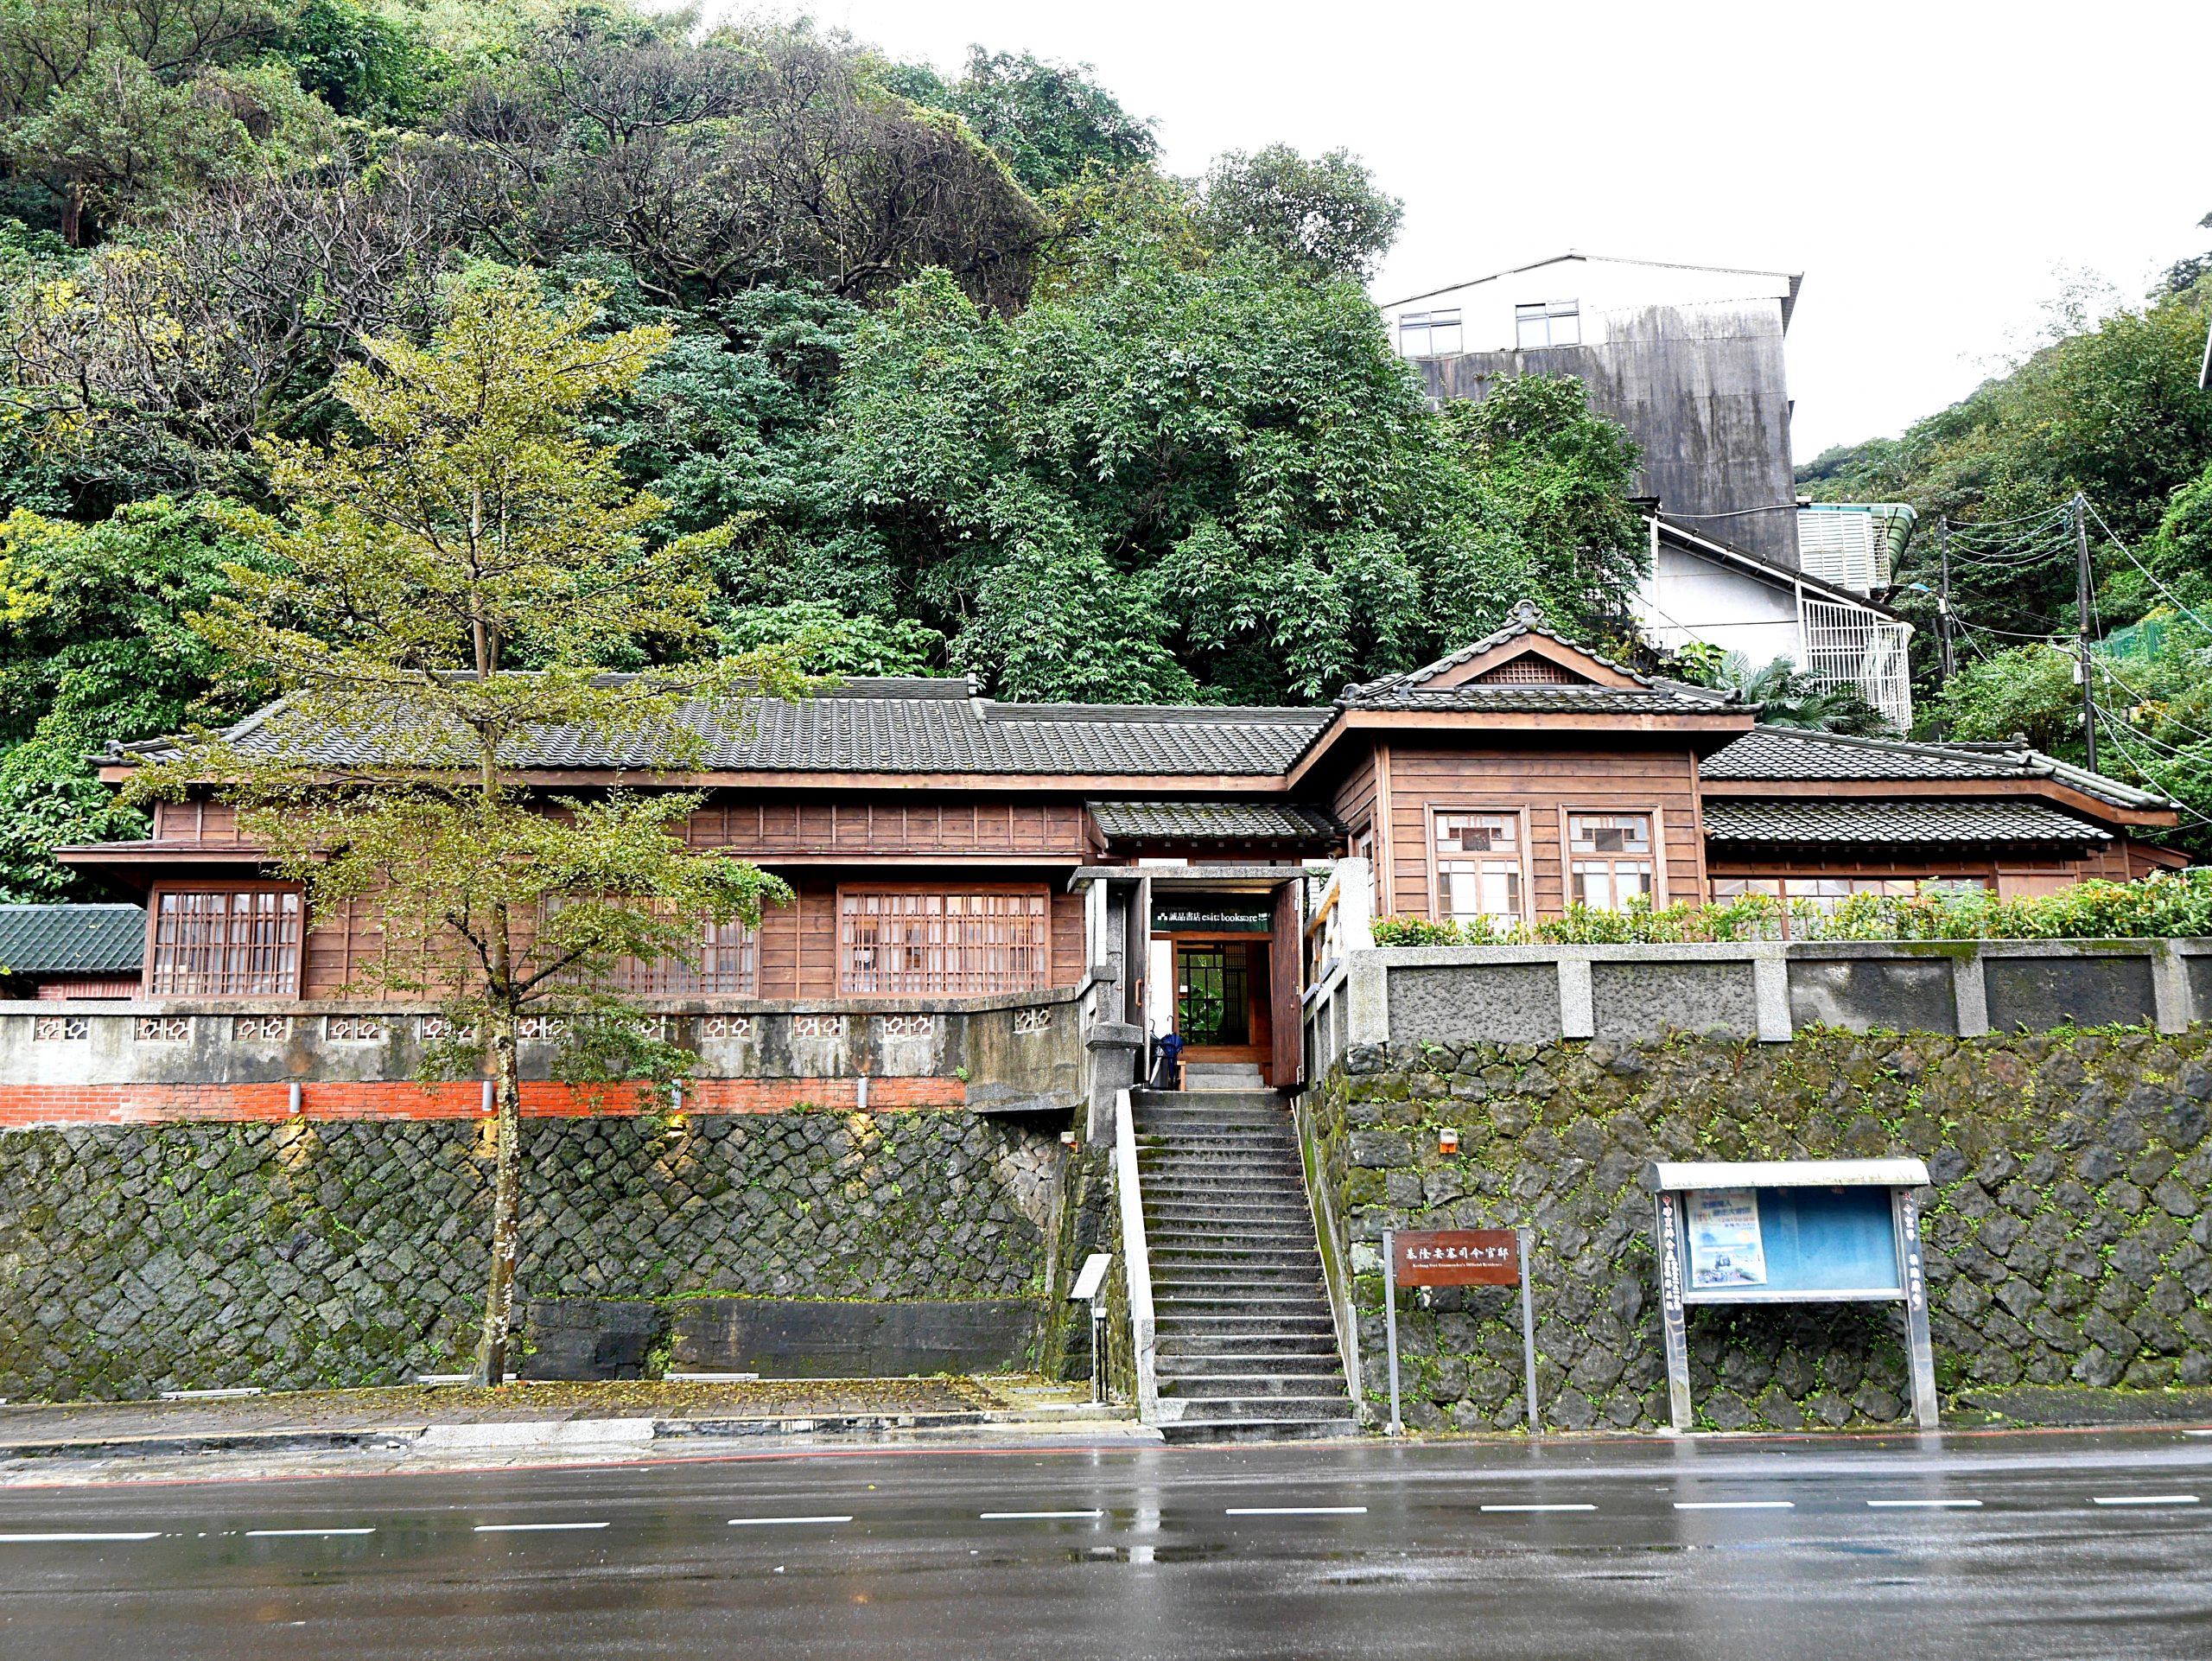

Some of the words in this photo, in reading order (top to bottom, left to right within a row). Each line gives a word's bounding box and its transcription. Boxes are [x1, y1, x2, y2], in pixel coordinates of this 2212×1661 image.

[1169, 912, 1200, 921] 誠品書店
[1221, 913, 1257, 922] bookstore
[1406, 1246, 1510, 1261] 基隆要塞司令官邸
